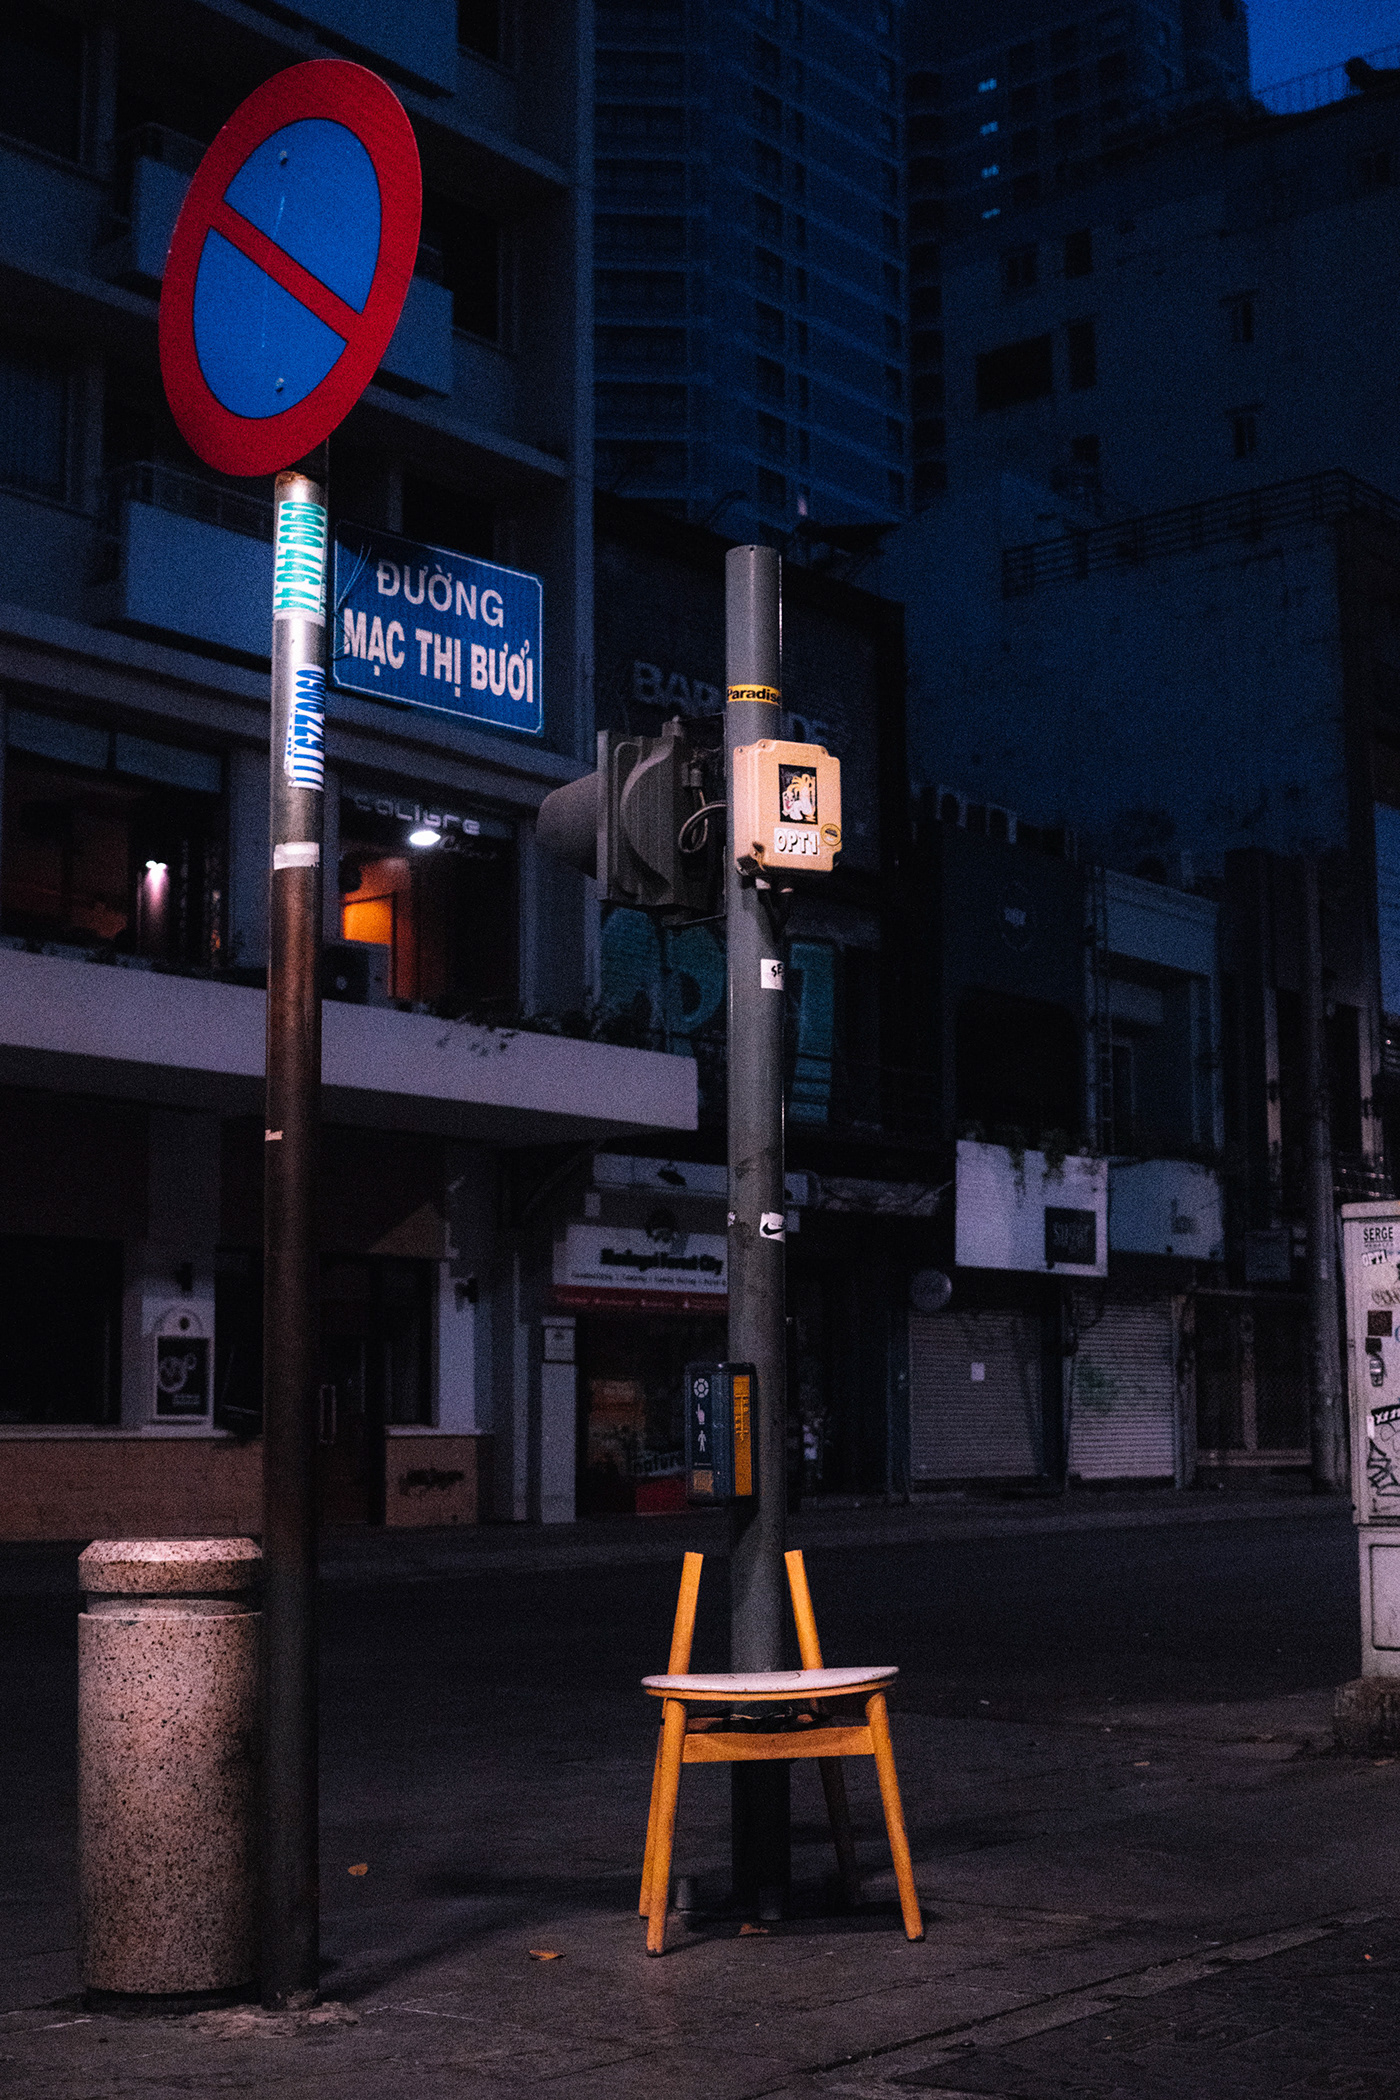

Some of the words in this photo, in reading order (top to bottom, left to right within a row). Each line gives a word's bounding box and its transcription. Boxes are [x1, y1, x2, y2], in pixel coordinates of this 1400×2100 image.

[376, 558, 504, 628] ĐƯỜNG
[343, 608, 405, 677] MẠC
[415, 628, 461, 698] THỊ
[471, 639, 534, 703] BƯỞI
[1363, 1226, 1394, 1241] SERGE
